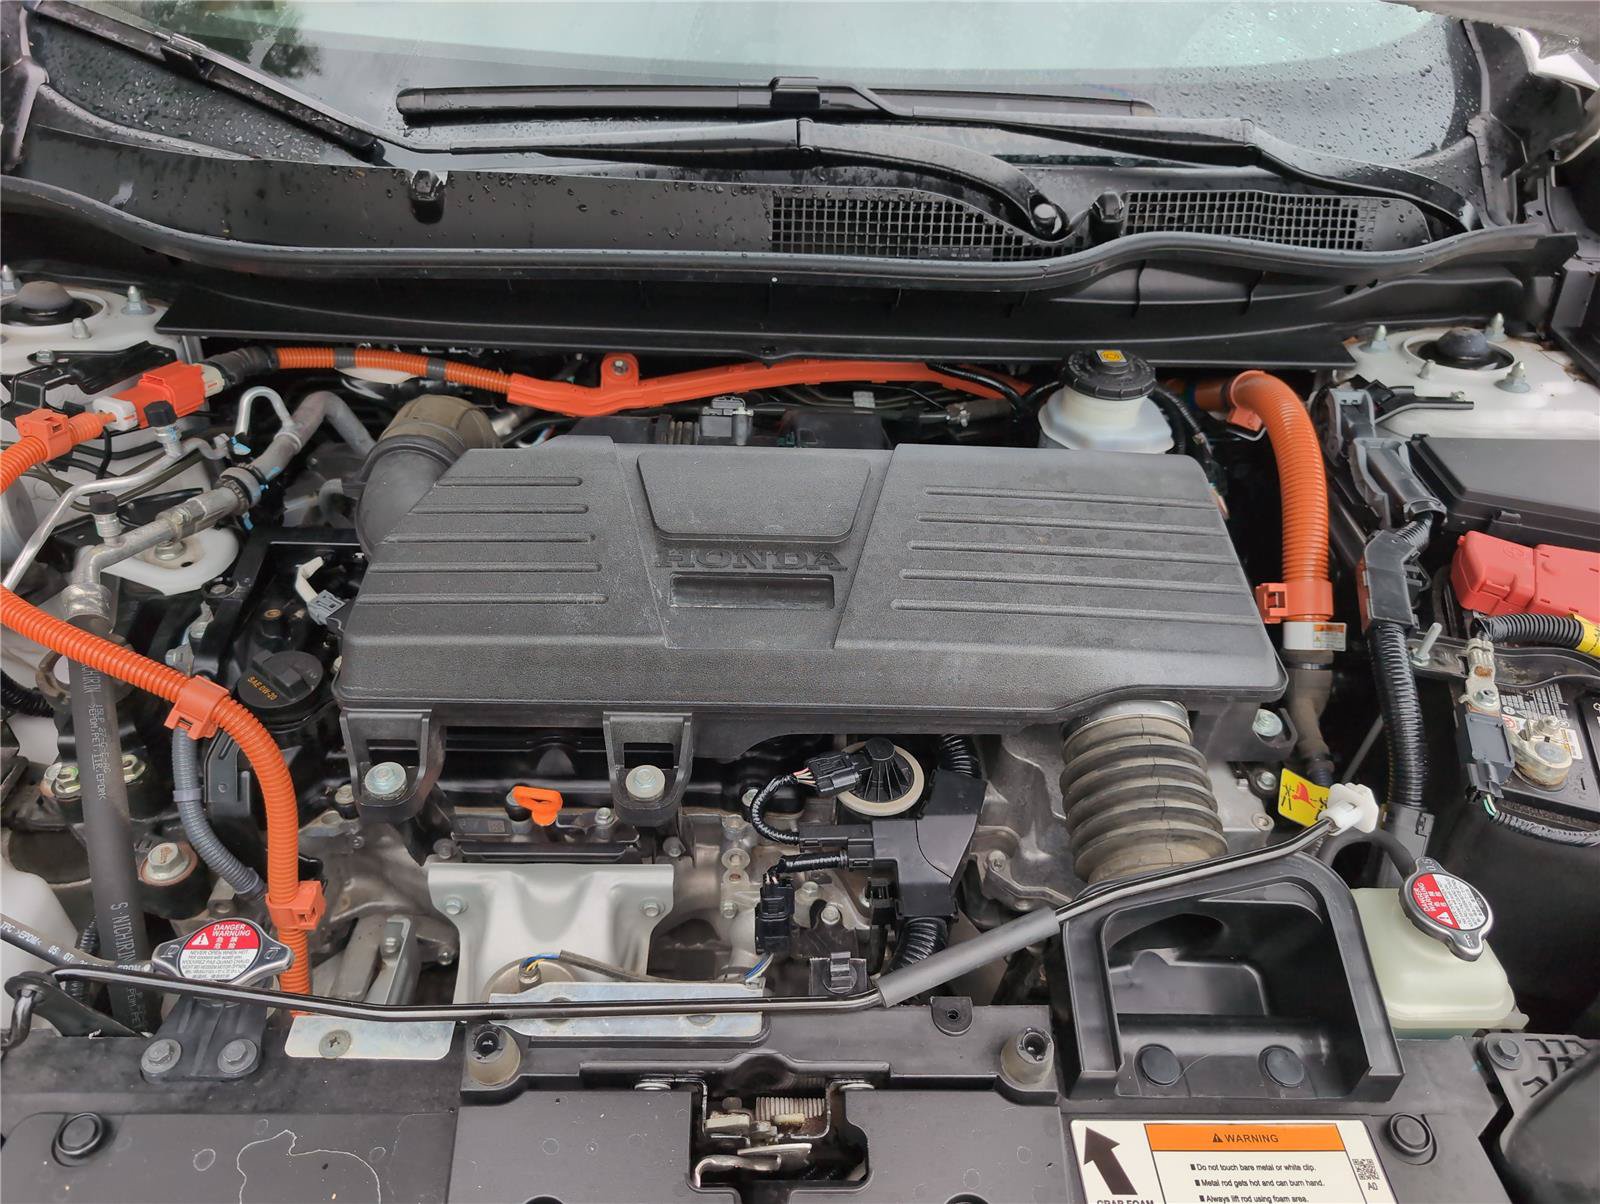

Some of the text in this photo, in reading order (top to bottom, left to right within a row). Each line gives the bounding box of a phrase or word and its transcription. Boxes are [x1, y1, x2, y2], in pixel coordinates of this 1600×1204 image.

[656, 549, 848, 571] HONDA
[247, 675, 262, 688] SAE
[1225, 1134, 1279, 1144] WARNING
[1303, 1164, 1317, 1173] clip.
[1234, 1180, 1249, 1189] gets
[1206, 1196, 1231, 1204] Always
[1253, 1195, 1272, 1204] using
